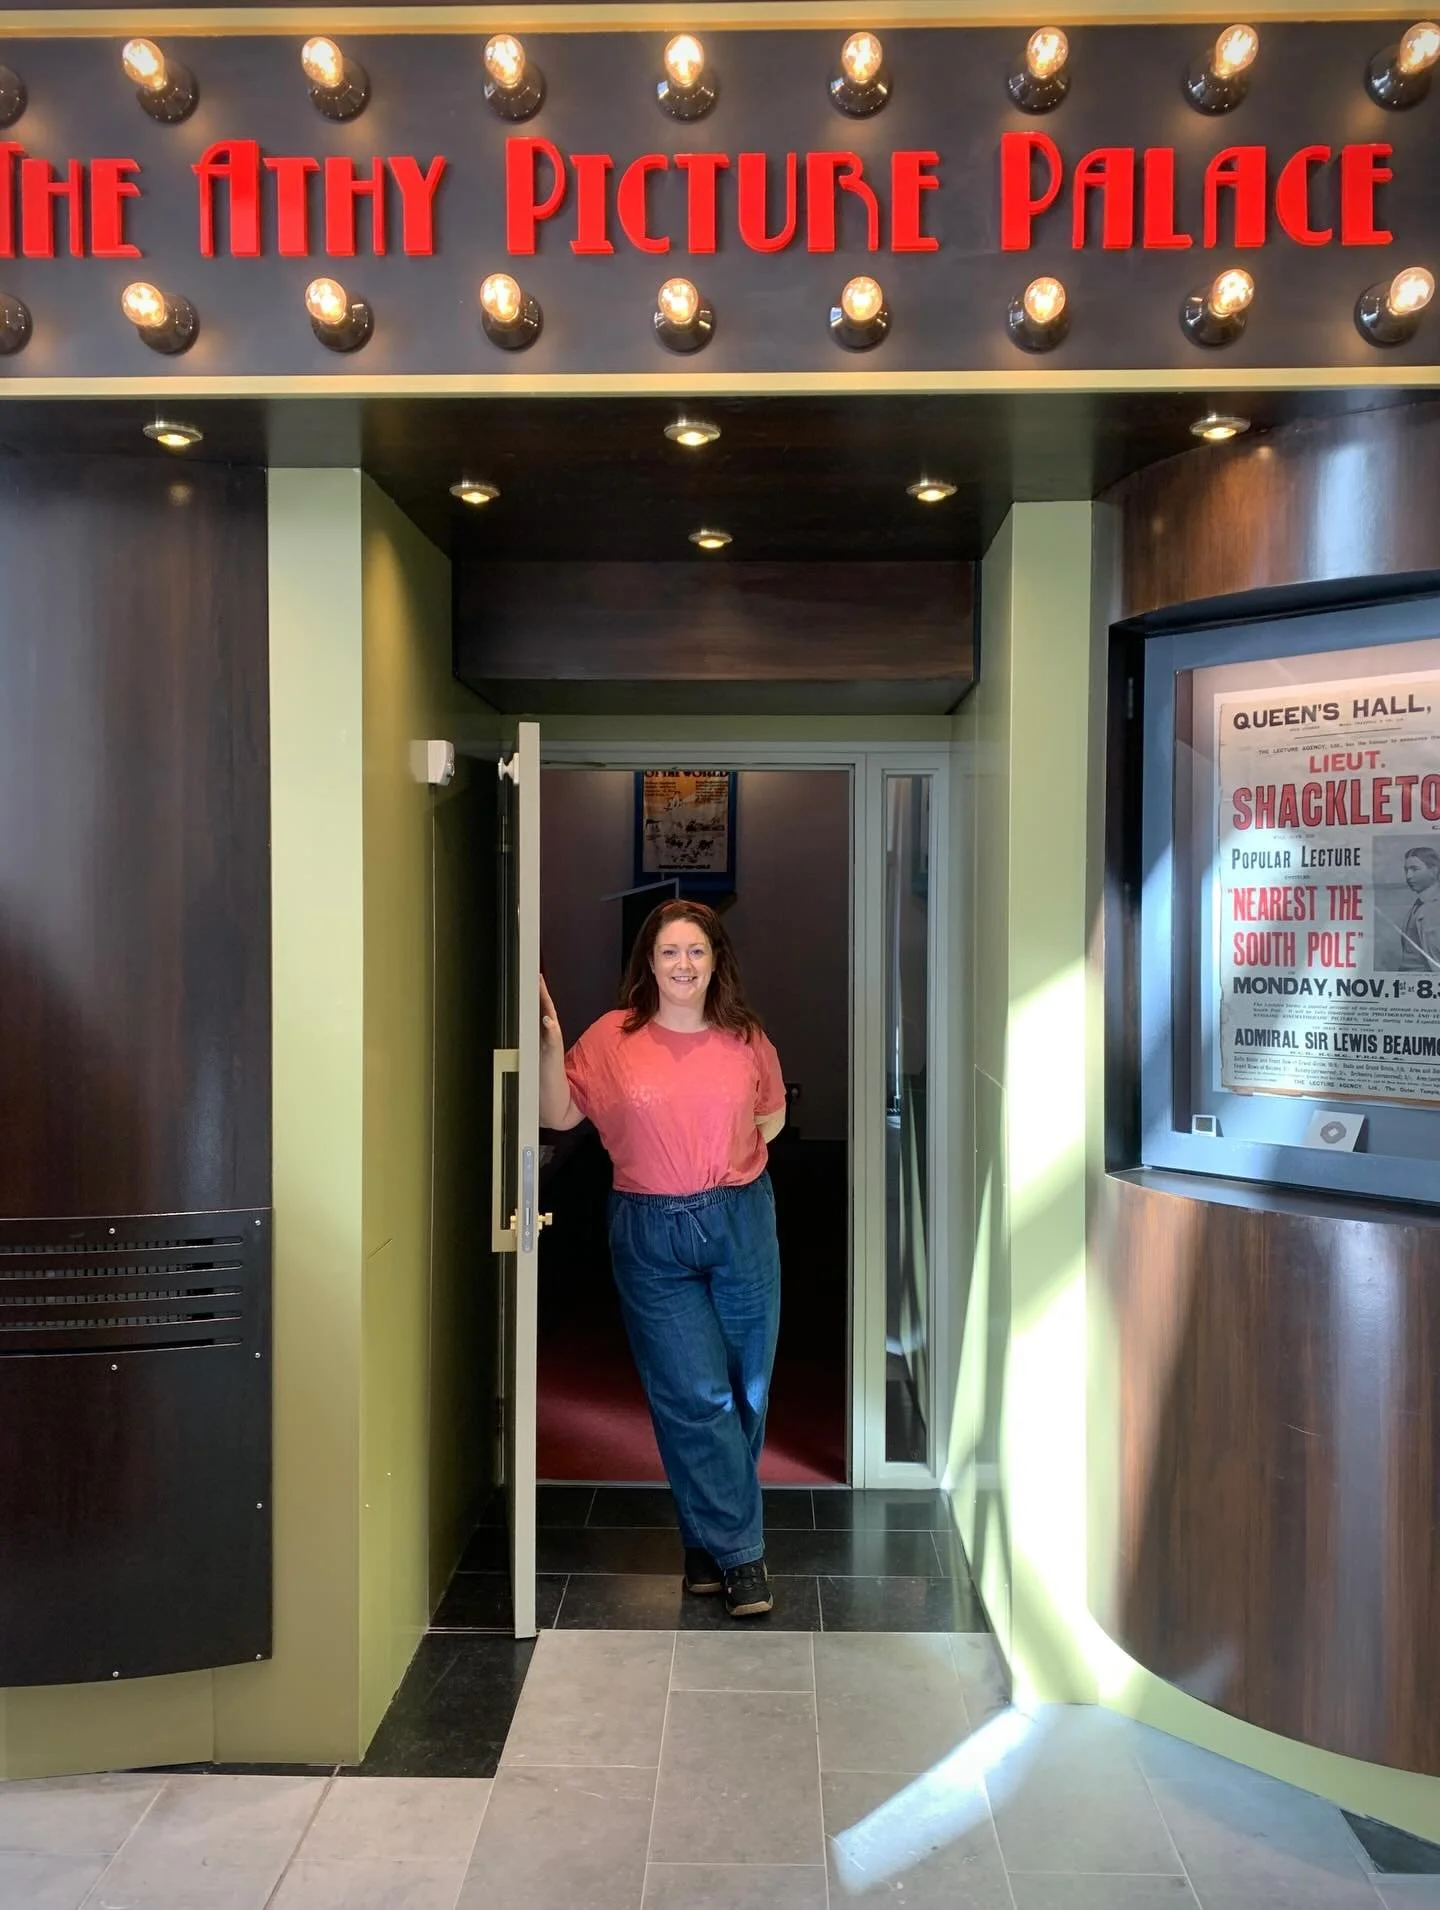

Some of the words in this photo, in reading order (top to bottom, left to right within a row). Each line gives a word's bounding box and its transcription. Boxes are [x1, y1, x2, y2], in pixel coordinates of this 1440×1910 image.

[191, 138, 447, 258] ATHY
[505, 136, 940, 255] PICTURE
[1000, 131, 1394, 252] PALACE
[1233, 702, 1340, 730] QUEEN'S
[1353, 694, 1432, 719] HALL,
[1309, 750, 1386, 773] LIEUT.
[1231, 847, 1291, 869] POPULAR
[1301, 845, 1361, 868] LECTURE
[1326, 884, 1364, 921] THE
[1233, 931, 1296, 968] SOUTH
[1307, 931, 1364, 968] POLE"
[1233, 976, 1332, 998] MONDAY,
[1336, 978, 1390, 998] NOV.
[1234, 1028, 1299, 1049] ADMIRAL
[1305, 1031, 1329, 1051] SIR
[1333, 1032, 1378, 1054] LEWIS
